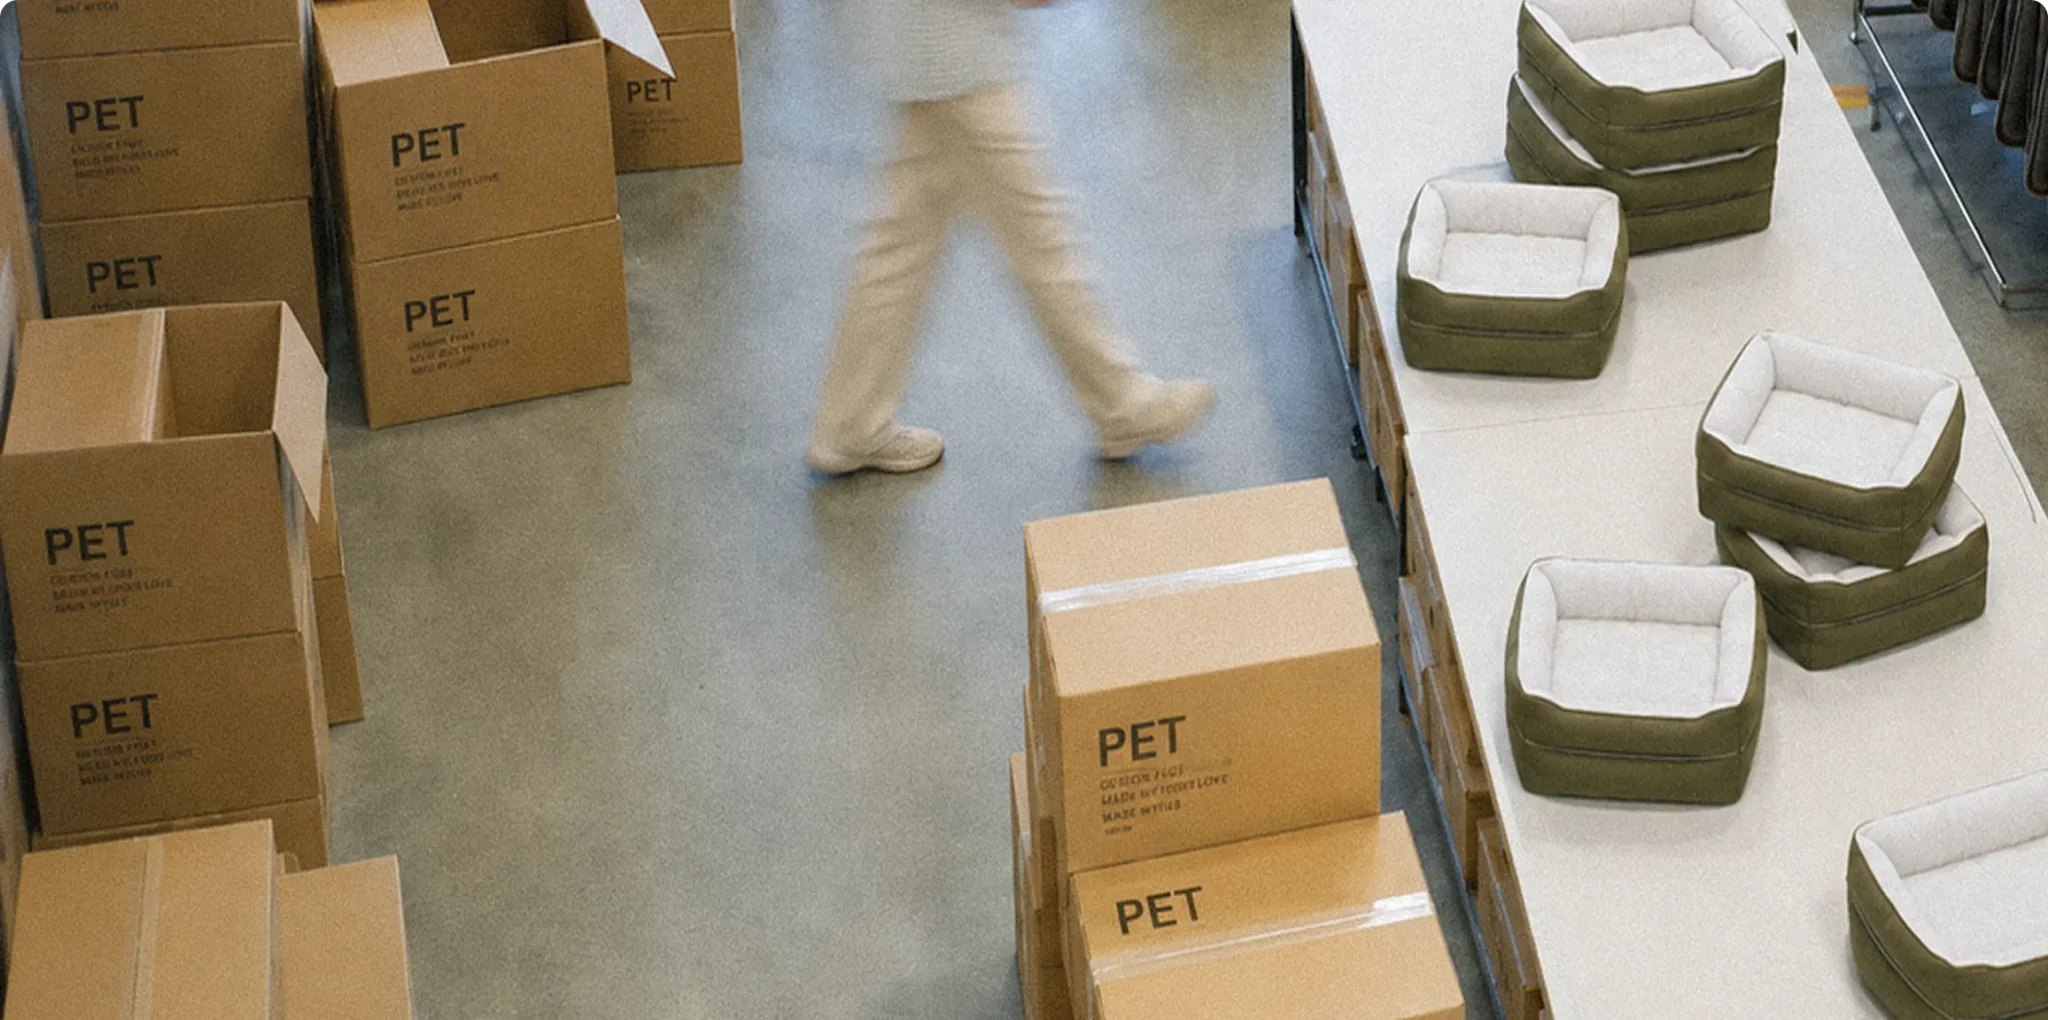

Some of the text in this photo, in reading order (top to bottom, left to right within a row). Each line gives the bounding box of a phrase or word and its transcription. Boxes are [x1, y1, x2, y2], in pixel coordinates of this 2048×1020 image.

[626, 78, 678, 104] PET
[66, 95, 145, 134] PET
[391, 122, 466, 168] PET
[86, 254, 162, 293] PET
[404, 289, 476, 332] PET
[45, 520, 135, 565] PET
[70, 693, 159, 738] PET
[1099, 715, 1187, 767] PET
[1116, 886, 1203, 935] PET
